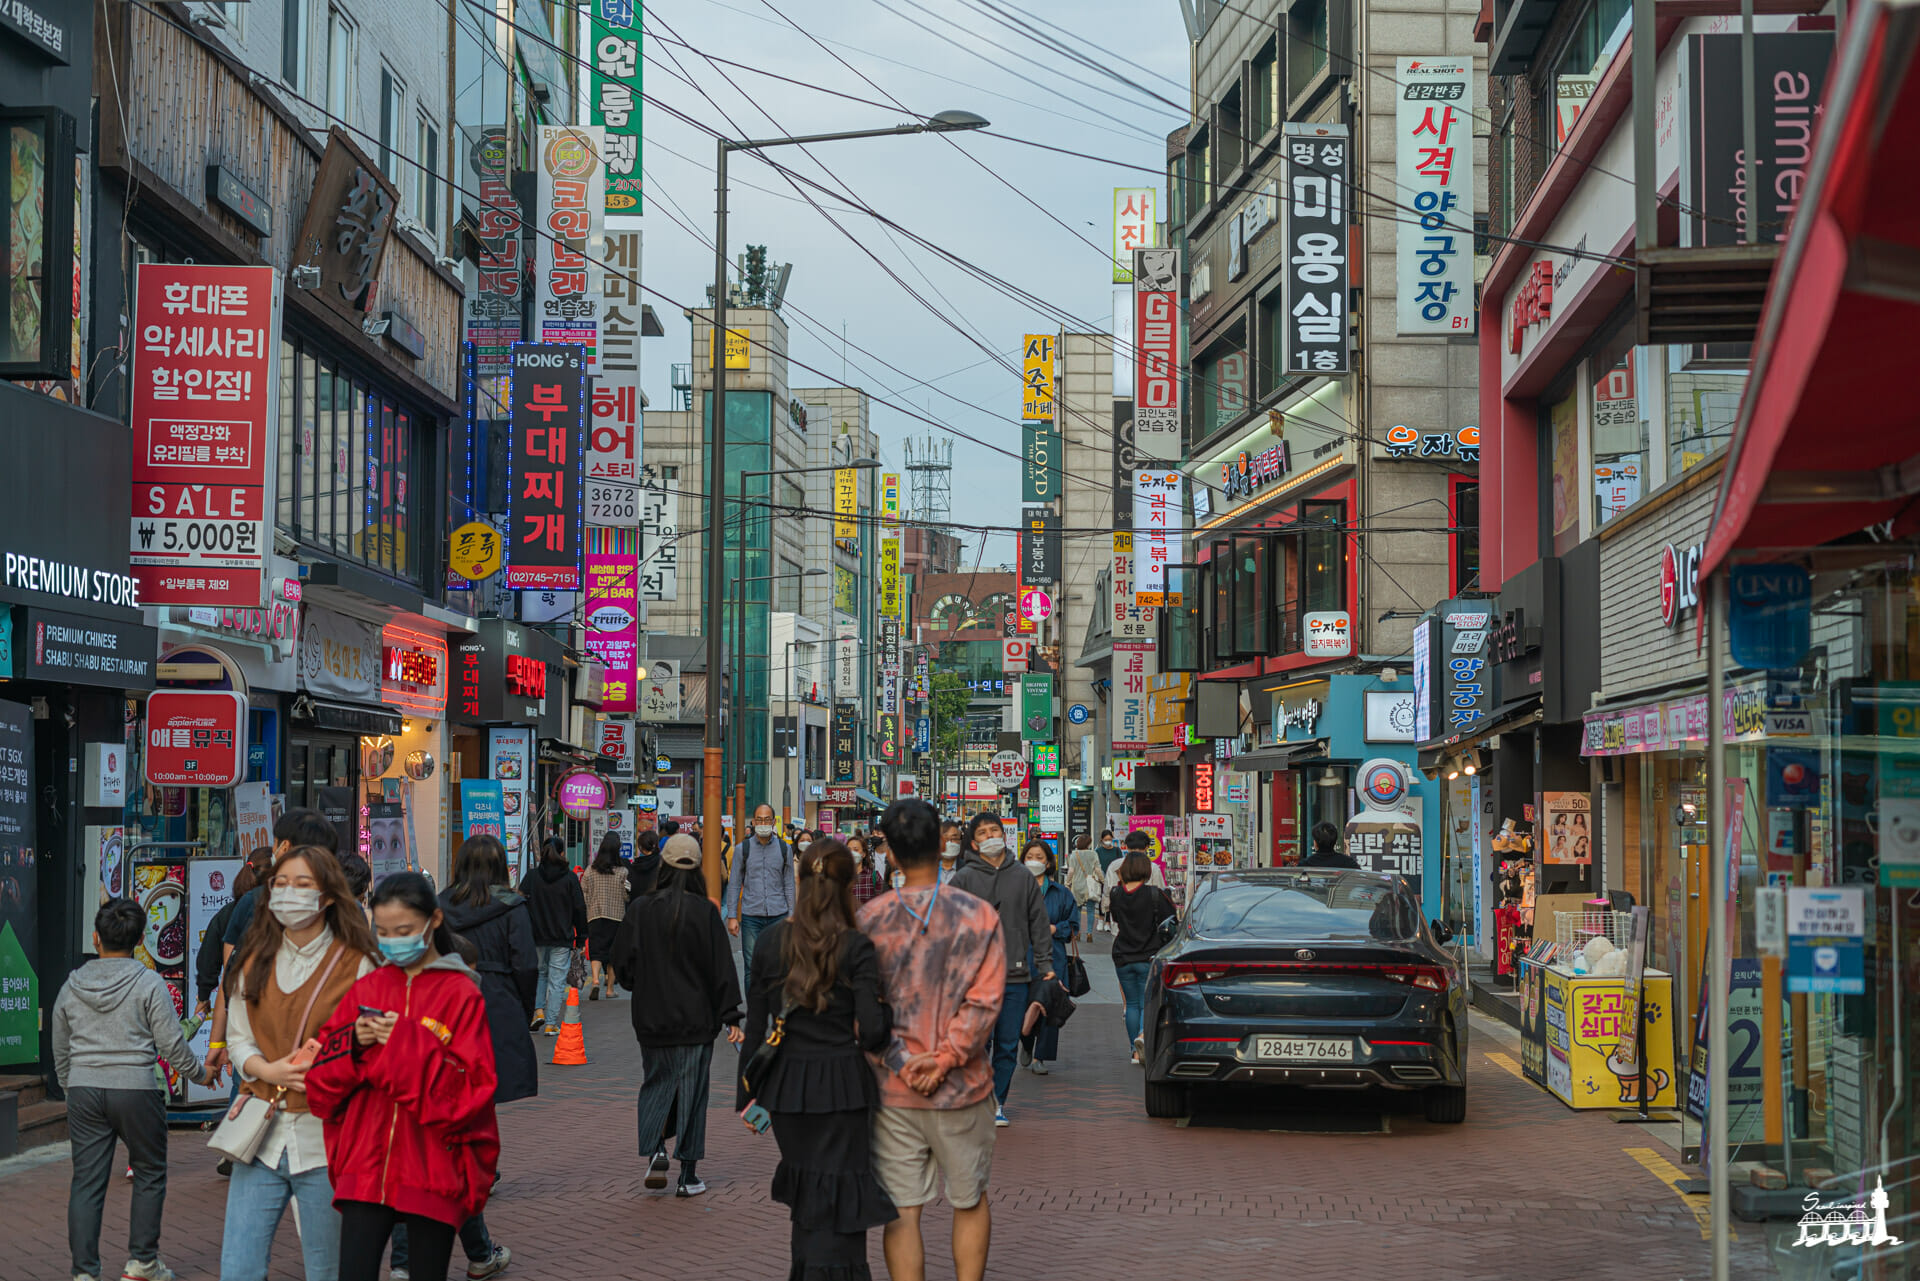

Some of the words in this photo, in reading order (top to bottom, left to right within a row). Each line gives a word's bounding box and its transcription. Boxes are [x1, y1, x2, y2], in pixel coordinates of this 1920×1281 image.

[12, 4, 63, 53] 대학로본점
[1407, 84, 1462, 99] 실감반동
[544, 128, 558, 140] B1
[1412, 105, 1457, 186] 사격
[1291, 143, 1343, 166] 명성
[1121, 194, 1150, 250] 사진
[1291, 174, 1345, 343] 미용실
[1413, 190, 1457, 321] 양궁장
[163, 282, 249, 316] 휴대폰
[544, 300, 597, 318] 연습장
[1452, 316, 1469, 329] B1
[144, 326, 264, 359] 악세사리
[517, 353, 579, 369] HONG's
[1025, 338, 1053, 397] 사주
[1295, 350, 1339, 370] 1층
[152, 366, 252, 401] 할인점!
[1024, 401, 1052, 415] 까페
[1138, 409, 1176, 418] 코인노래
[591, 386, 635, 459] 헤어
[1138, 420, 1178, 432] 연습장
[170, 424, 231, 440] 액정강화
[1386, 425, 1479, 461] 유자유
[153, 445, 211, 462] 유리필름
[214, 447, 246, 462] 부착
[523, 384, 568, 552] 부대찌개
[590, 463, 635, 478] 스토리
[1035, 429, 1048, 496] LLOYD
[1139, 473, 1178, 490] 유자유
[148, 486, 247, 517] SALE
[592, 489, 634, 501] 3672
[592, 505, 634, 517] 7200
[1027, 510, 1049, 518] 대학로
[163, 521, 256, 554] 5,000원
[1031, 536, 1045, 573] 부동산
[6, 552, 88, 600] PREMIUM
[93, 570, 140, 608] STORE
[208, 580, 229, 591] 제외
[509, 572, 575, 583] (02)745-7151
[884, 548, 897, 606] 헤어살롱
[1679, 546, 1698, 609] LG
[610, 588, 634, 598] BAR
[1114, 556, 1128, 621] 감자탕
[1138, 595, 1179, 604] 742-136
[593, 615, 629, 625] Fruits
[1310, 619, 1347, 634] 유자유
[1455, 620, 1484, 628] STORY
[46, 624, 84, 645] PREMIUM
[85, 630, 117, 650] CHINESE
[1123, 624, 1146, 634] 전문
[1460, 632, 1482, 641] 프리
[460, 644, 485, 652] HONG's
[586, 641, 604, 649] DIY
[1311, 639, 1348, 649] 김치떡볶이
[45, 649, 73, 666] SHABU
[73, 655, 100, 671] SHABU
[101, 657, 148, 676] RESTAURANT
[1124, 653, 1143, 693] 맥주
[462, 653, 480, 717] 부대찌개
[1450, 658, 1485, 733] 양궁장
[1124, 699, 1139, 741] Mart
[1773, 717, 1805, 730] VISA
[151, 728, 233, 749] 애플뮤직
[838, 716, 852, 775] 노래방
[7, 749, 23, 764] 5GX
[250, 751, 264, 760] ADT
[186, 761, 197, 770] 3F
[991, 762, 1025, 777] 부동산
[0, 766, 28, 786] 우드게임
[153, 772, 186, 781] 10:00am
[195, 773, 228, 782] 10:00pm
[566, 783, 602, 795] Fruits
[1199, 816, 1226, 830] 유자유
[1350, 833, 1384, 854] 실탄
[1391, 834, 1421, 854] 쏘는
[1296, 950, 1314, 959] KIA
[2, 977, 30, 994] 들어와서
[1582, 994, 1625, 1015] 갖고
[1580, 1017, 1622, 1038] 싶다
[1729, 1019, 1761, 1078] 2
